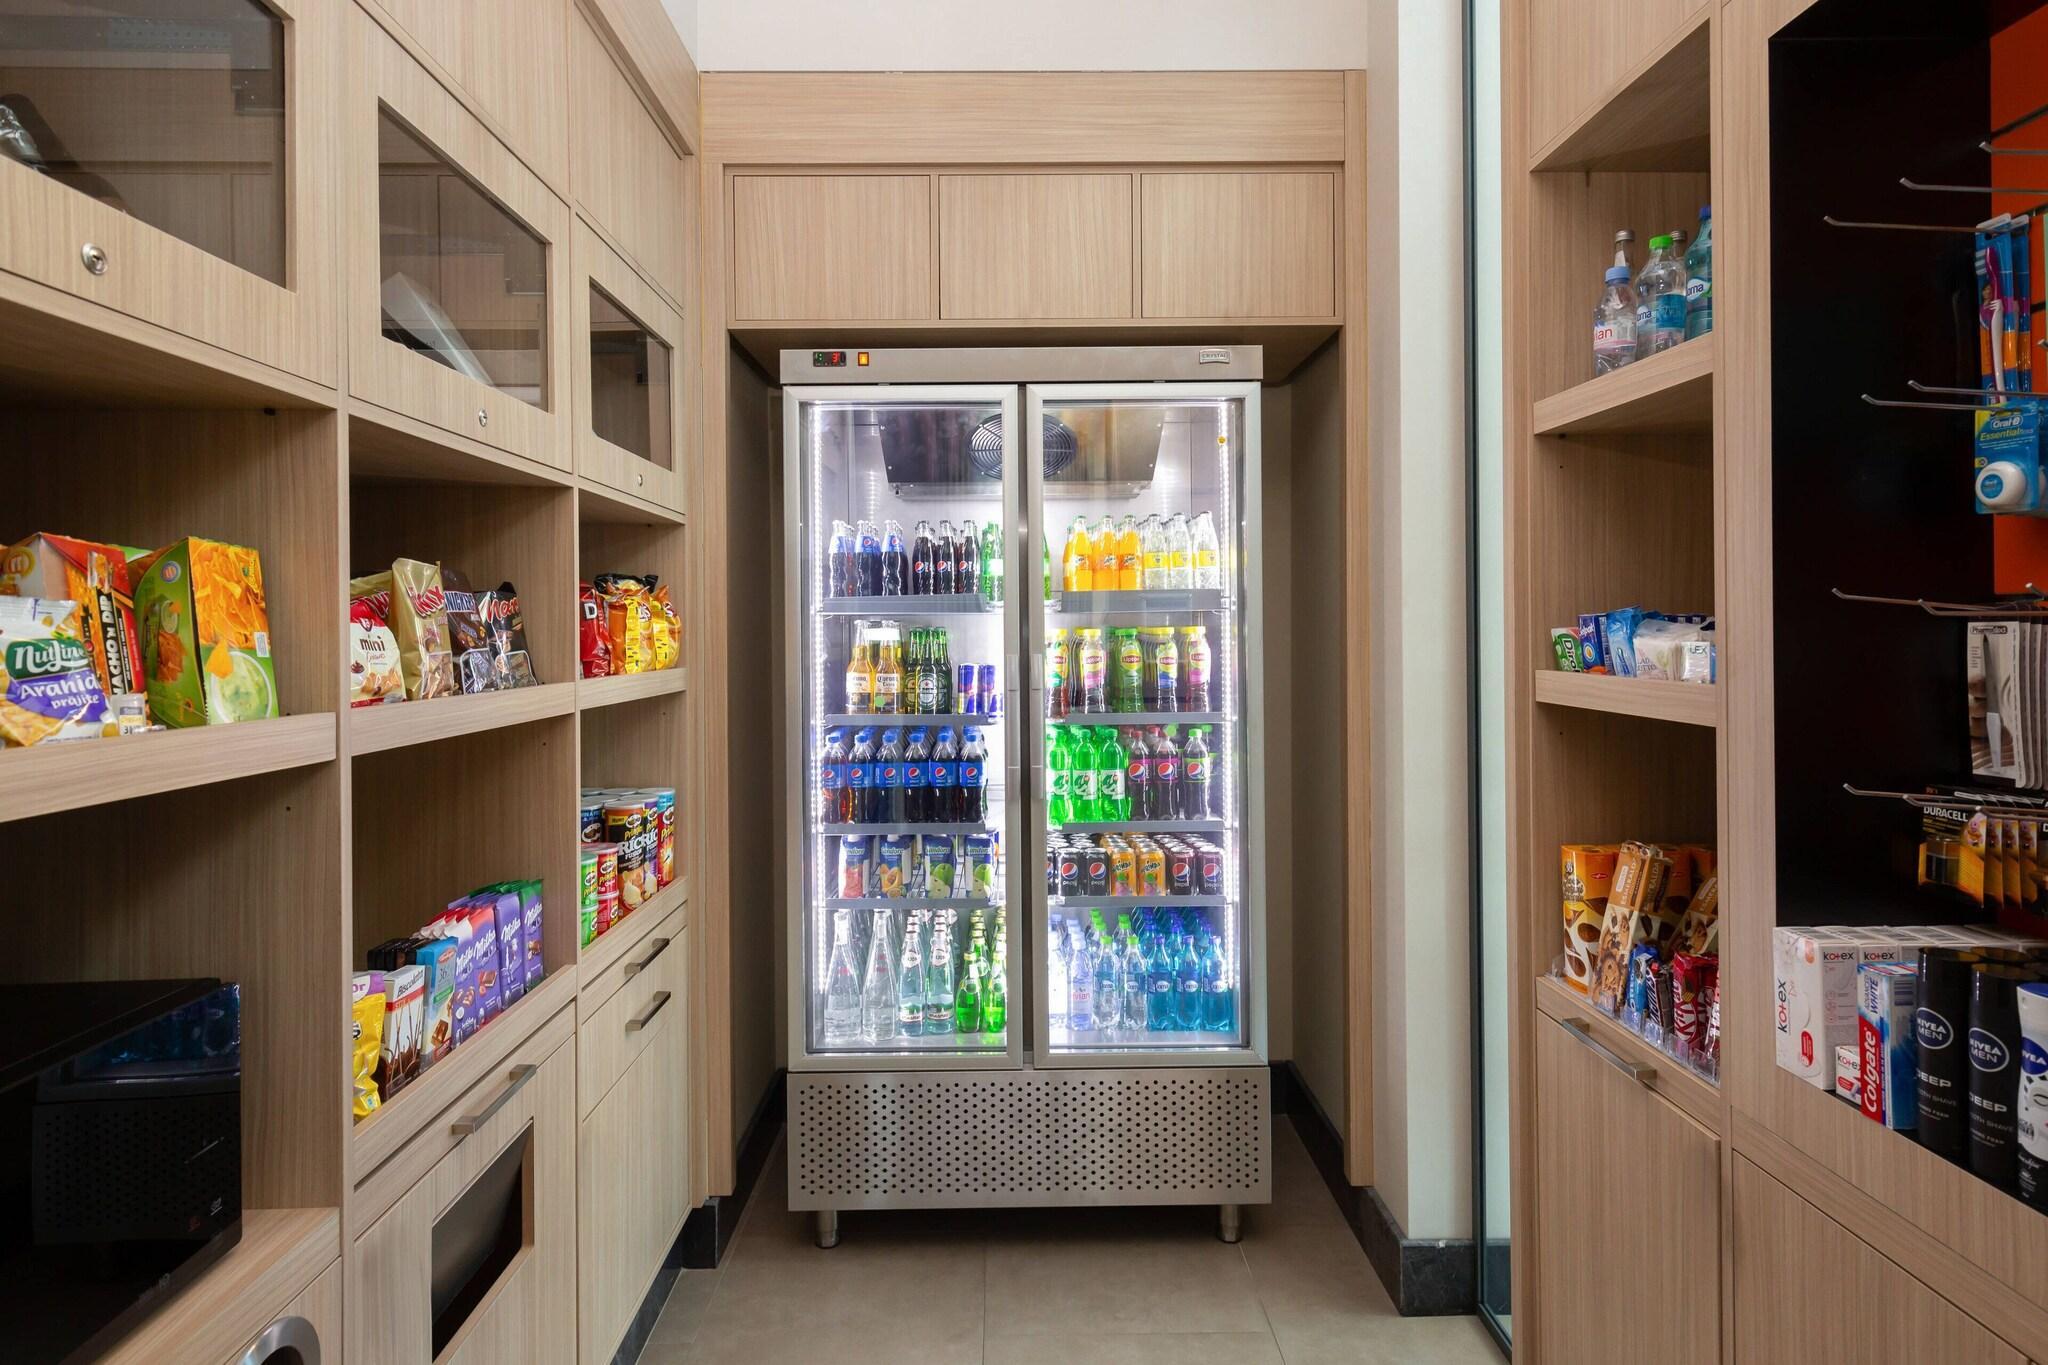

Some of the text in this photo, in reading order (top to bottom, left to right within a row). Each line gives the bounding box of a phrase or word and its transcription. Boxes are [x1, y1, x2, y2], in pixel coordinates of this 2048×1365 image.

[1594, 327, 1613, 341] ian
[99, 594, 113, 623] DIP
[360, 633, 385, 652] mini
[20, 673, 100, 700] Arahid
[1923, 805, 1969, 823] DURACELL
[525, 902, 543, 926] Milka
[501, 917, 522, 943] Milka
[474, 929, 496, 960] Milka
[1823, 951, 1854, 961] kotex
[1864, 951, 1895, 961] kotex
[1869, 976, 1879, 1015] WHITE
[1777, 978, 1787, 1034] kotex
[1917, 1018, 1948, 1036] NIVEA
[1918, 1027, 1943, 1042] MEN
[1969, 1036, 2002, 1057] NIVEA
[1971, 1047, 1998, 1064] MEN
[2021, 1049, 2048, 1066] IVEA
[1864, 1029, 1880, 1113] Colgate
